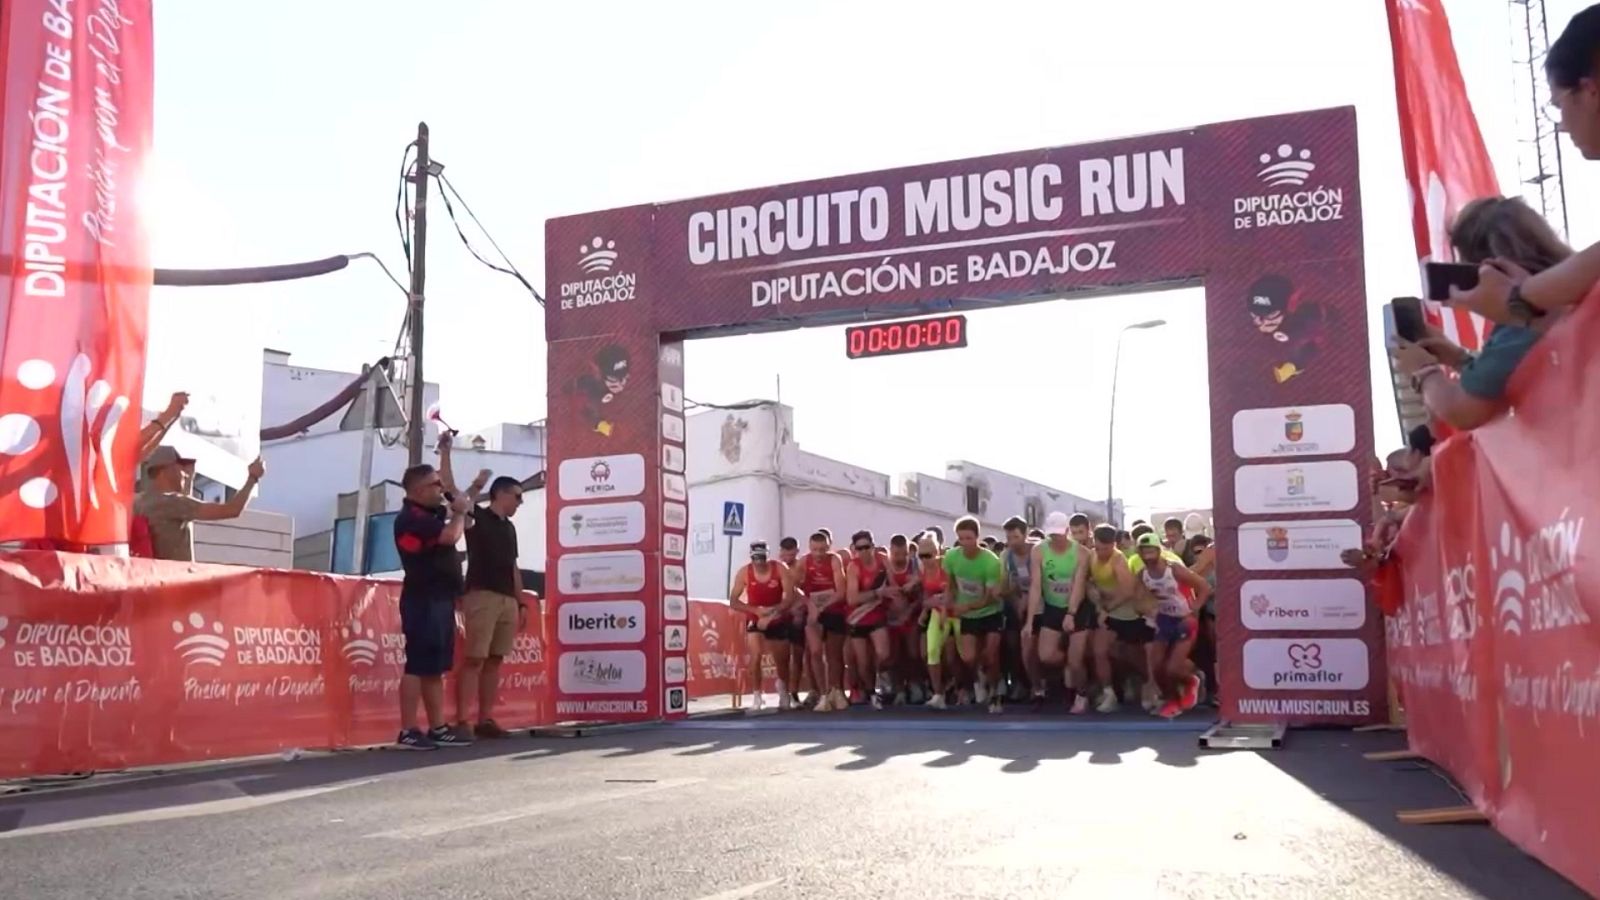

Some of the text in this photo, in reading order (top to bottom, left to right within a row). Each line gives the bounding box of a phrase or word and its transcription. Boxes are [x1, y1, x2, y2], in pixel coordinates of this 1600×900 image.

[45, 42, 71, 80] DE
[88, 44, 123, 85] el
[94, 86, 131, 152] por
[24, 82, 70, 297] DIPUTACIÓN
[1234, 185, 1343, 214] DIPUTACIÓN
[688, 147, 1186, 265] CIRCUITO MUSIC RUN
[1234, 203, 1343, 229] DE BADAJOZ
[561, 270, 636, 297] DIPUTACIÓN
[752, 240, 1117, 307] DIPUTACIÓN DE BADAJOZ
[561, 286, 636, 310] DE BADAJOZ
[850, 319, 960, 354] 00:00:00
[569, 613, 637, 630] Iberitos
[1268, 607, 1310, 618] ribera
[16, 619, 132, 646] DIPUTACIÓN
[233, 624, 321, 645] DIPUTACIÓN
[14, 645, 136, 666] DE BADAJOZ
[237, 646, 322, 665] DE BADAJOZ
[235, 681, 260, 706] por
[264, 677, 277, 697] el
[1273, 670, 1343, 686] primaflor
[12, 685, 47, 714] por
[54, 680, 72, 706] el
[1238, 699, 1370, 716] WWW.MUSICRUN.ES
